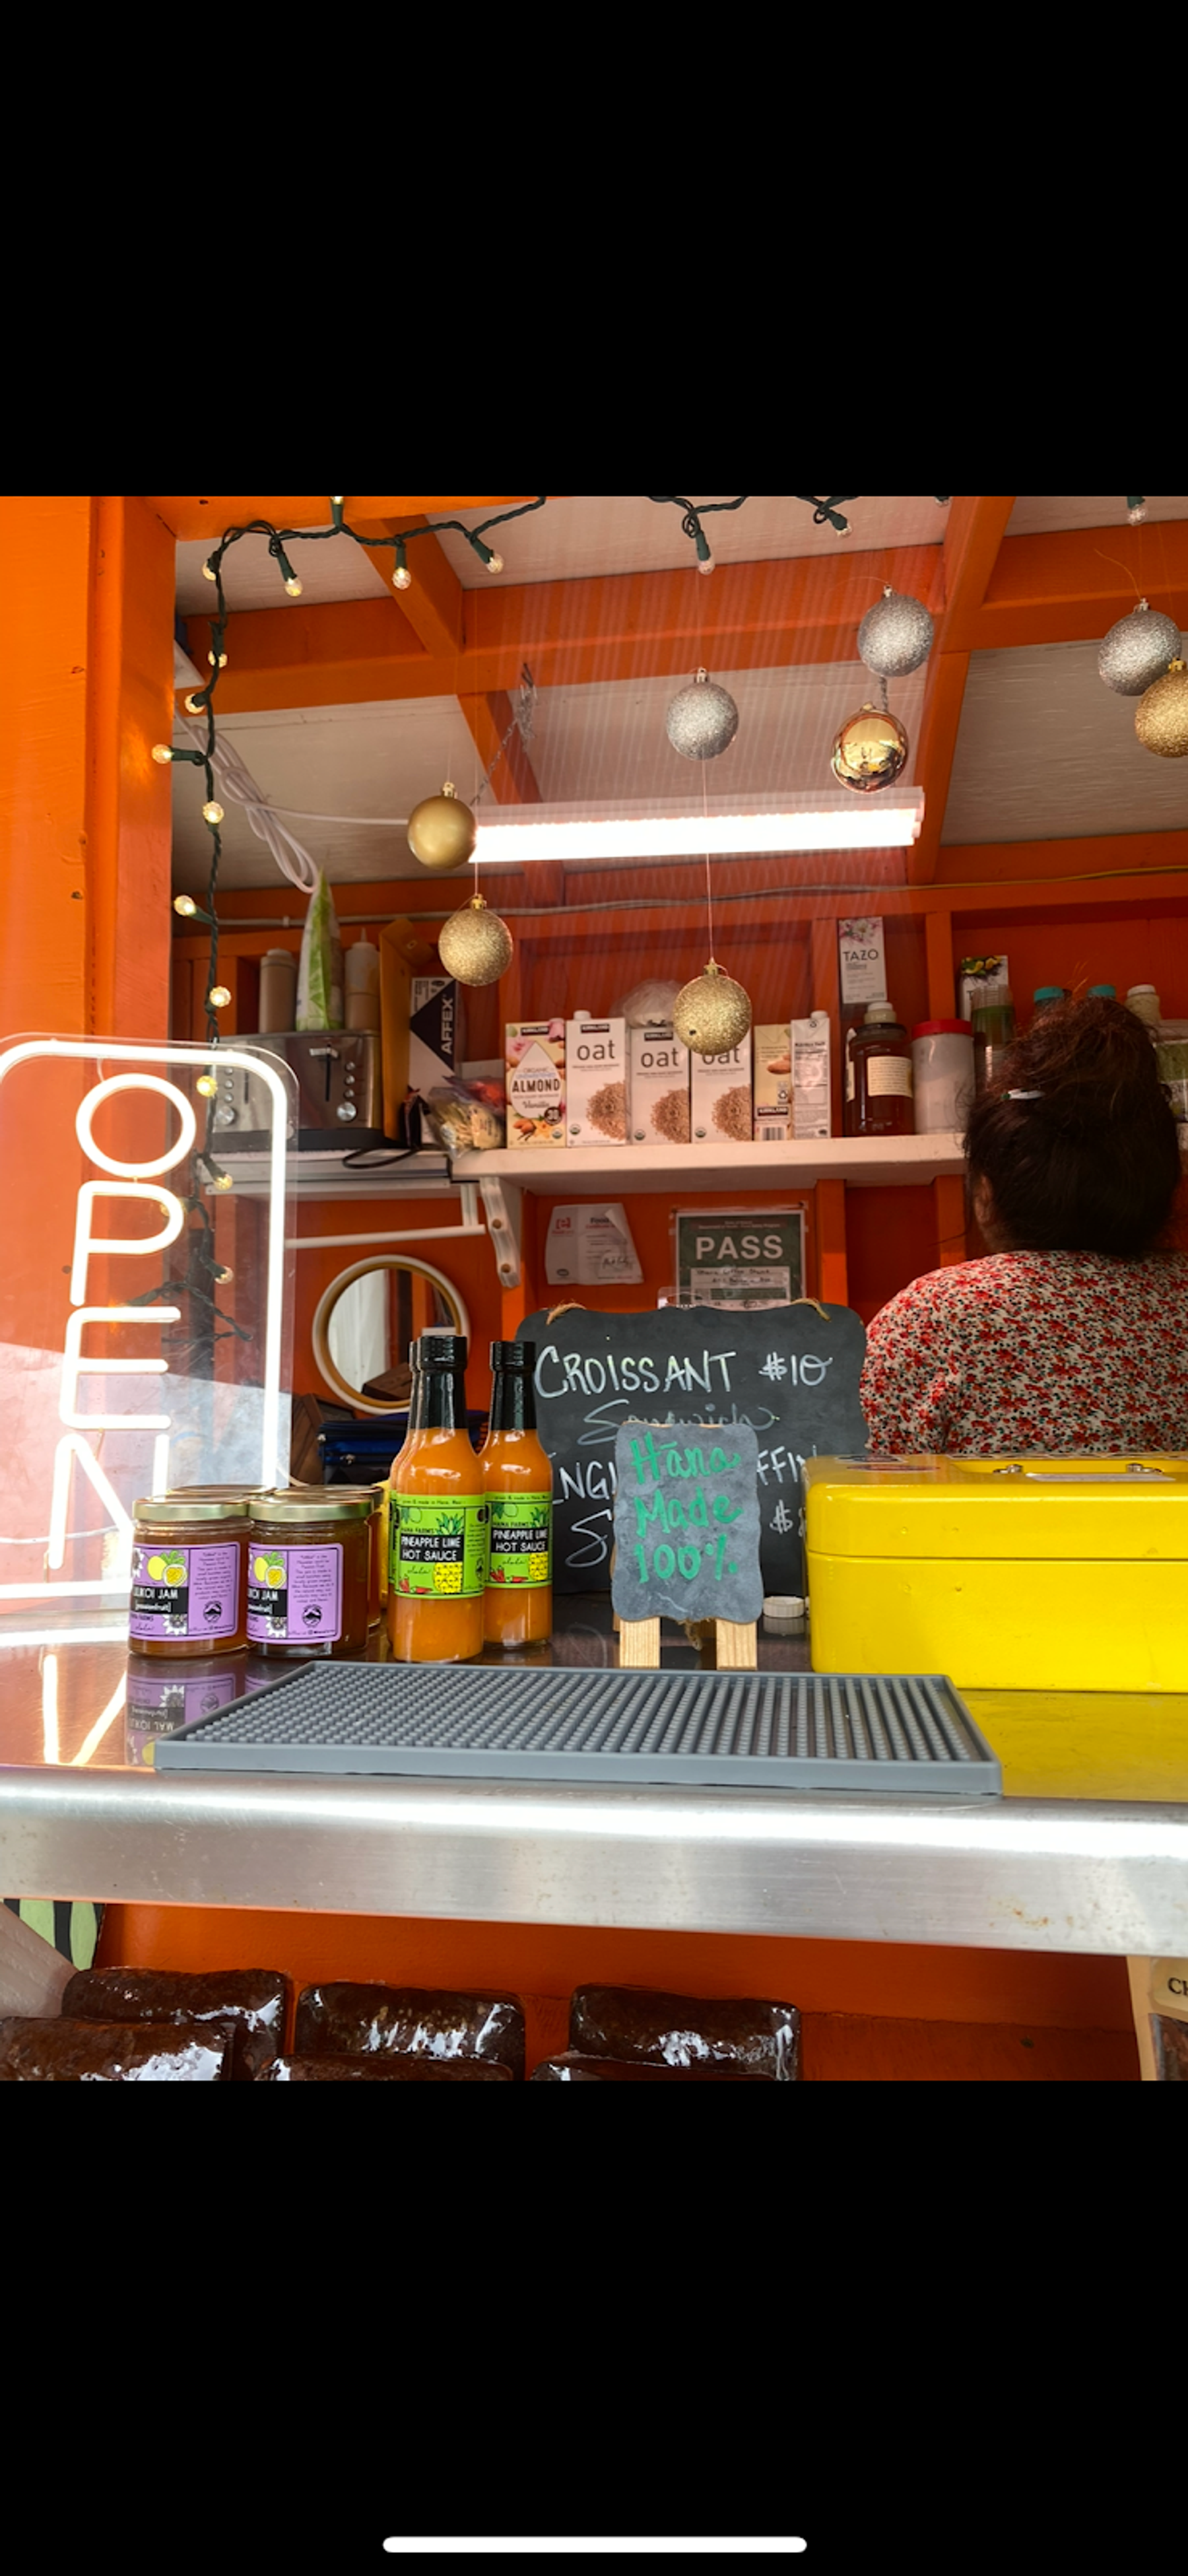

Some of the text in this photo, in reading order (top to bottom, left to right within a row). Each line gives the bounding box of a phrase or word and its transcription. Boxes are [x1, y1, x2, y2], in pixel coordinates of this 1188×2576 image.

[843, 949, 878, 961] TAZO
[441, 998, 453, 1054] AFFEX
[577, 1039, 615, 1060] oat
[641, 1047, 679, 1068] oat
[702, 1044, 740, 1065] oat
[512, 1078, 560, 1093] ALMOND
[696, 1235, 783, 1260] PASS
[48, 1073, 196, 1569] OPEN
[534, 1345, 832, 1398] CROISSANT $10
[634, 1486, 744, 1538] Made
[401, 1536, 461, 1547] PINEAPPLE LIME
[493, 1530, 533, 1540] PINEAPPLE
[403, 1549, 457, 1561] HOT SAUCE
[496, 1542, 546, 1551] HOT SAUCE
[634, 1534, 739, 1583] 100%
[158, 1589, 178, 1599] JAM
[261, 1590, 279, 1602] JAM
